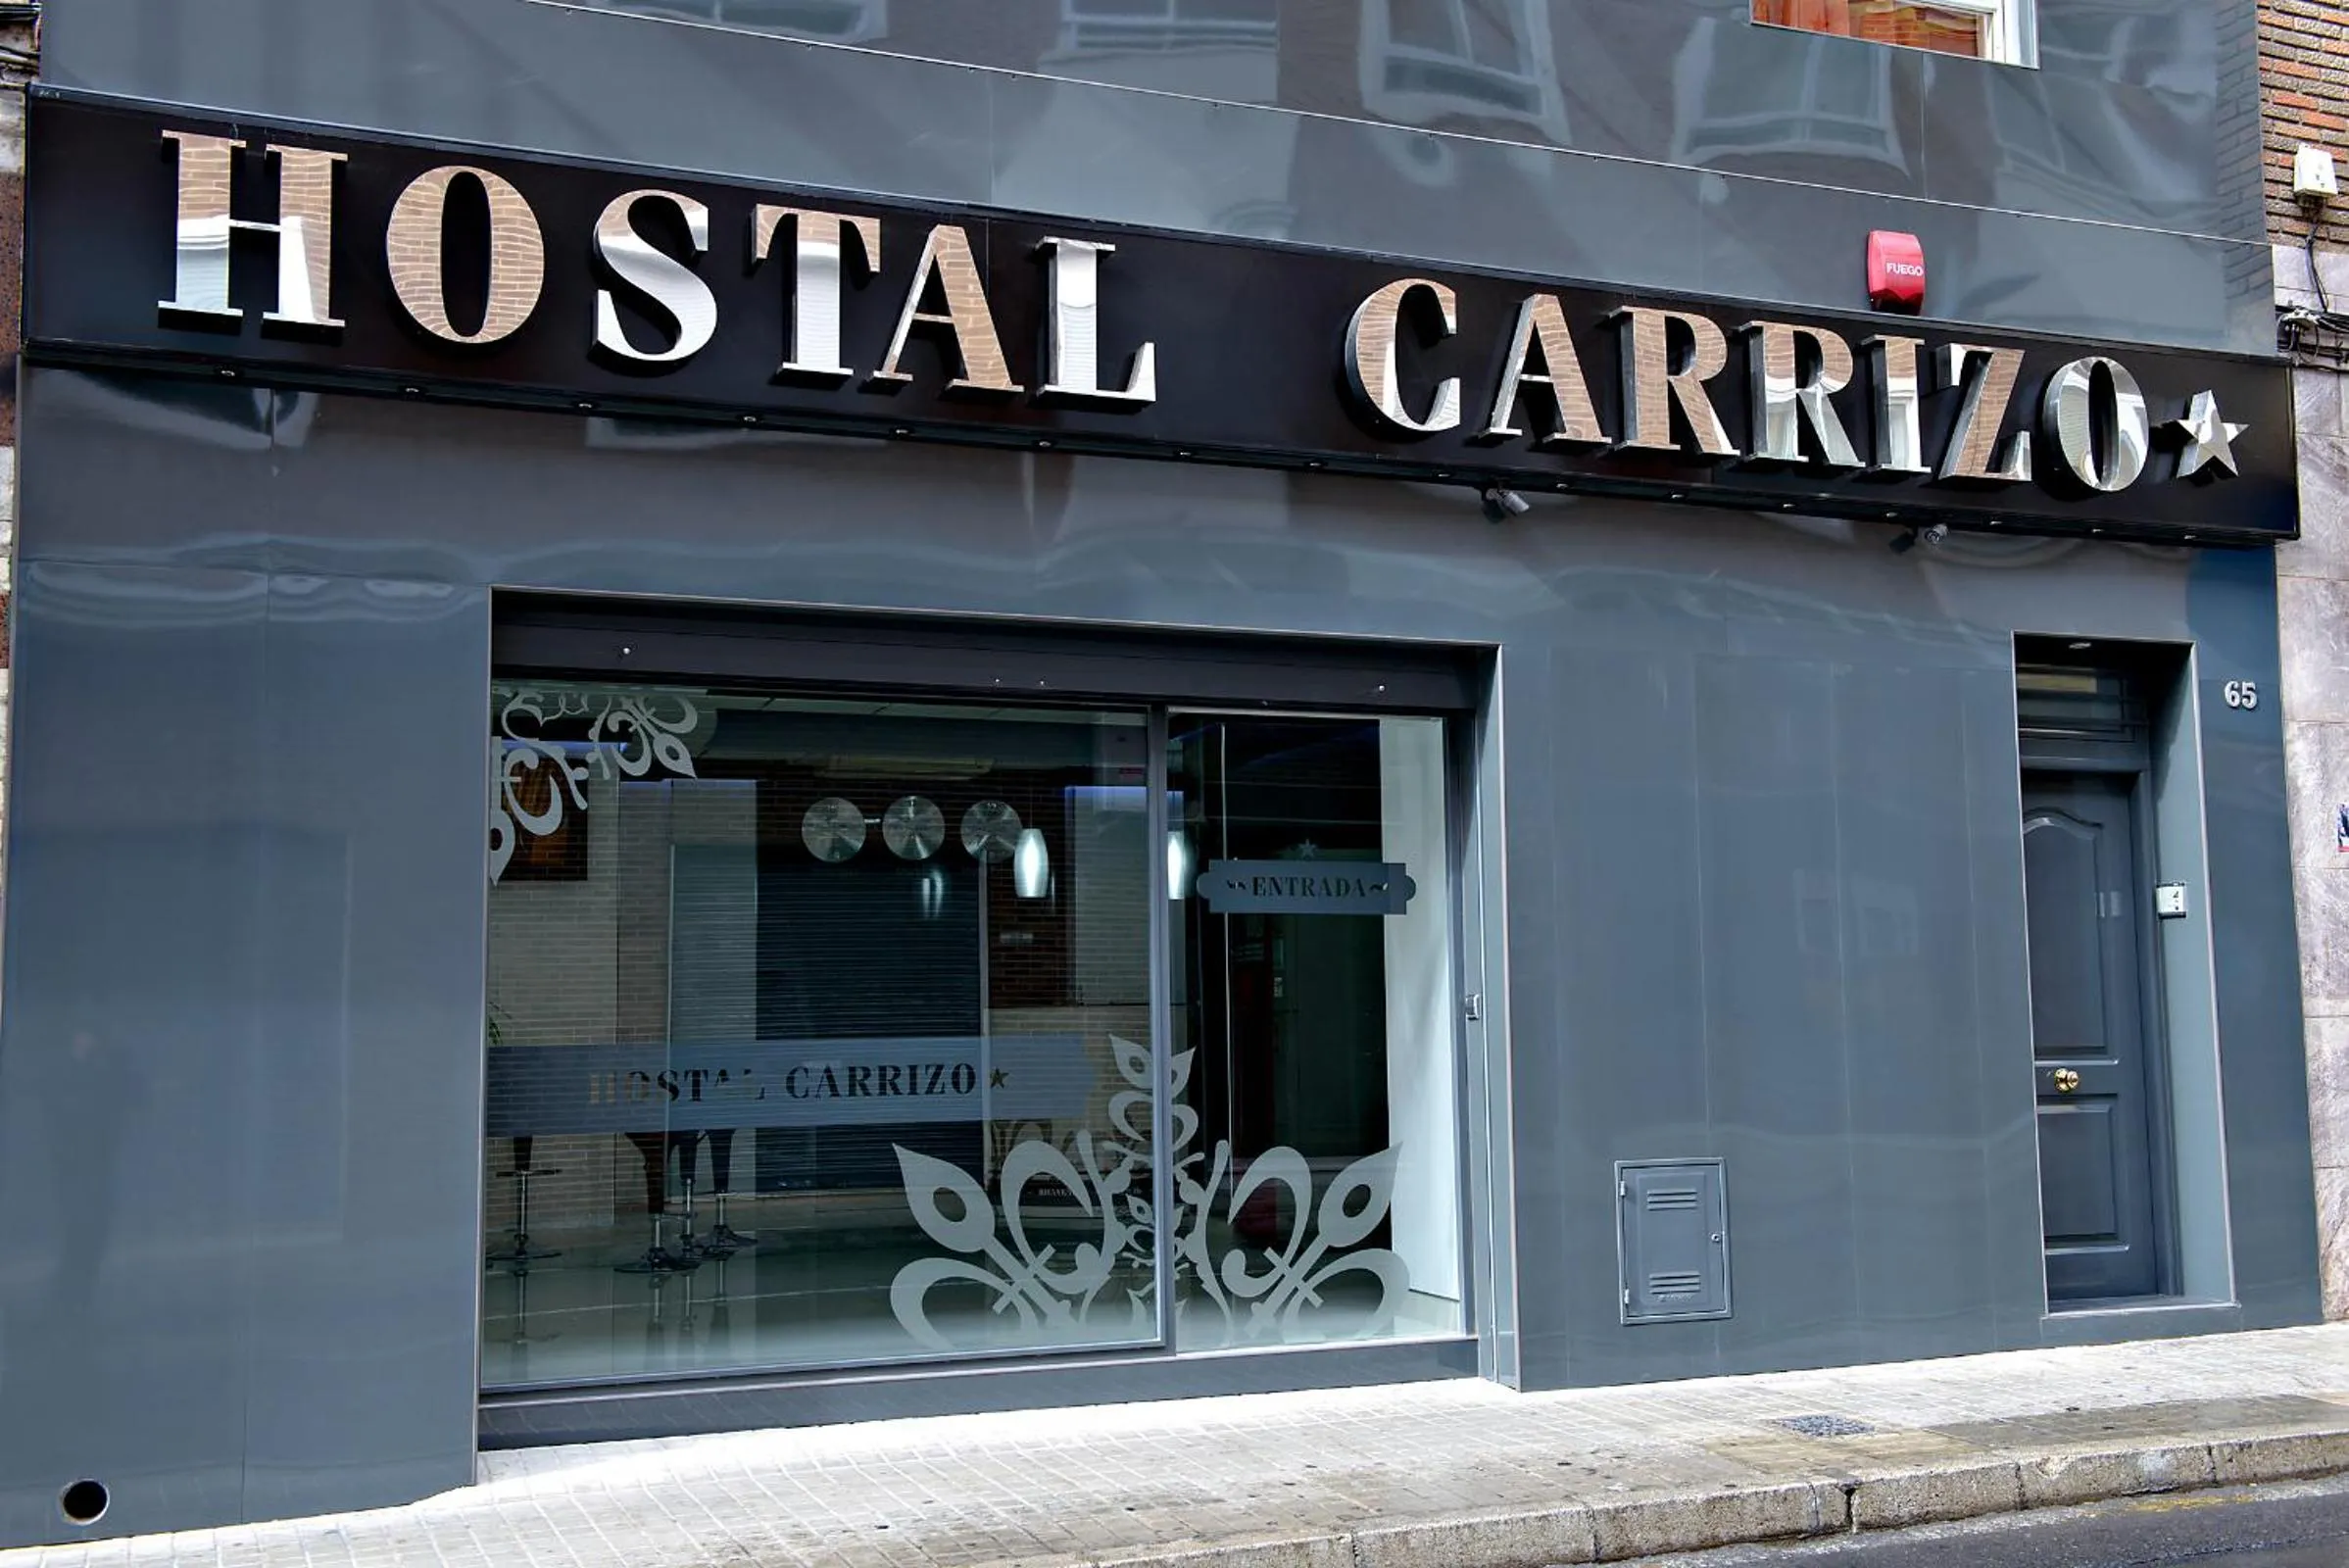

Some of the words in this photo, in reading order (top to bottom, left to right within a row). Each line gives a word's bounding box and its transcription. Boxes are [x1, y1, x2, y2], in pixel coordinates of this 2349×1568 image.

[1886, 262, 1925, 276] FUEGO
[158, 129, 1157, 404] HOSTAL
[1344, 277, 2150, 492] CARRIZO
[2225, 680, 2258, 709] 65
[1252, 876, 1366, 898] ENTRADA
[785, 1062, 976, 1099] CARRIZO
